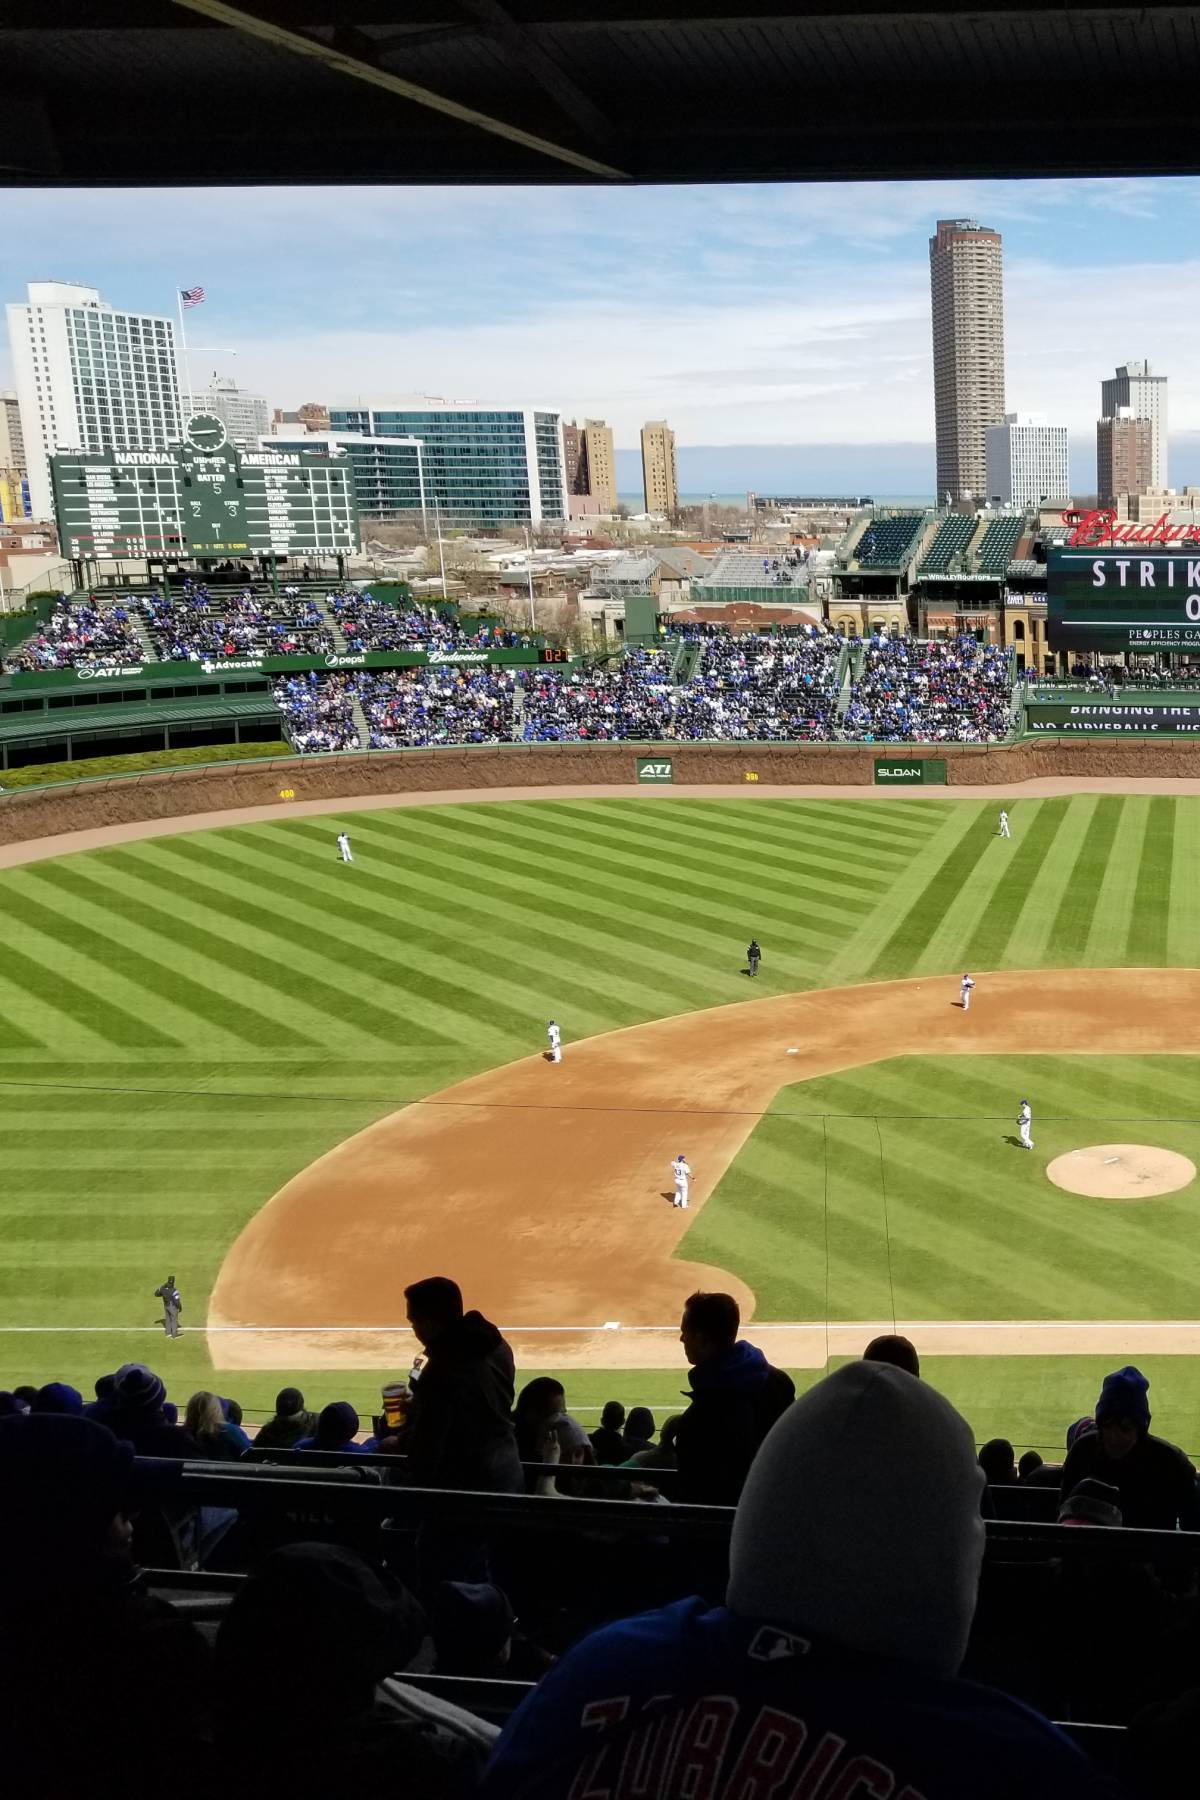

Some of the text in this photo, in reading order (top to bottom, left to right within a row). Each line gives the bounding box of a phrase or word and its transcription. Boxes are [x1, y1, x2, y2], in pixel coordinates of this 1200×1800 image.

[114, 452, 178, 464] NATIONAL
[240, 454, 300, 466] AMERICAN
[213, 482, 222, 494] 5
[192, 506, 202, 517] 2
[228, 506, 238, 516] 3
[1129, 629, 1180, 639] PEOPLES
[340, 654, 366, 668] pepsi
[427, 651, 489, 663] Budweiser
[216, 660, 262, 670] Advocate
[94, 668, 120, 678] ATI
[1070, 706, 1154, 715] BRINGING
[1162, 708, 1191, 716] THE
[640, 764, 672, 774] ATI
[878, 768, 922, 778] SLOAN
[280, 789, 294, 798] 400
[567, 1694, 928, 1800] ZOBRI
